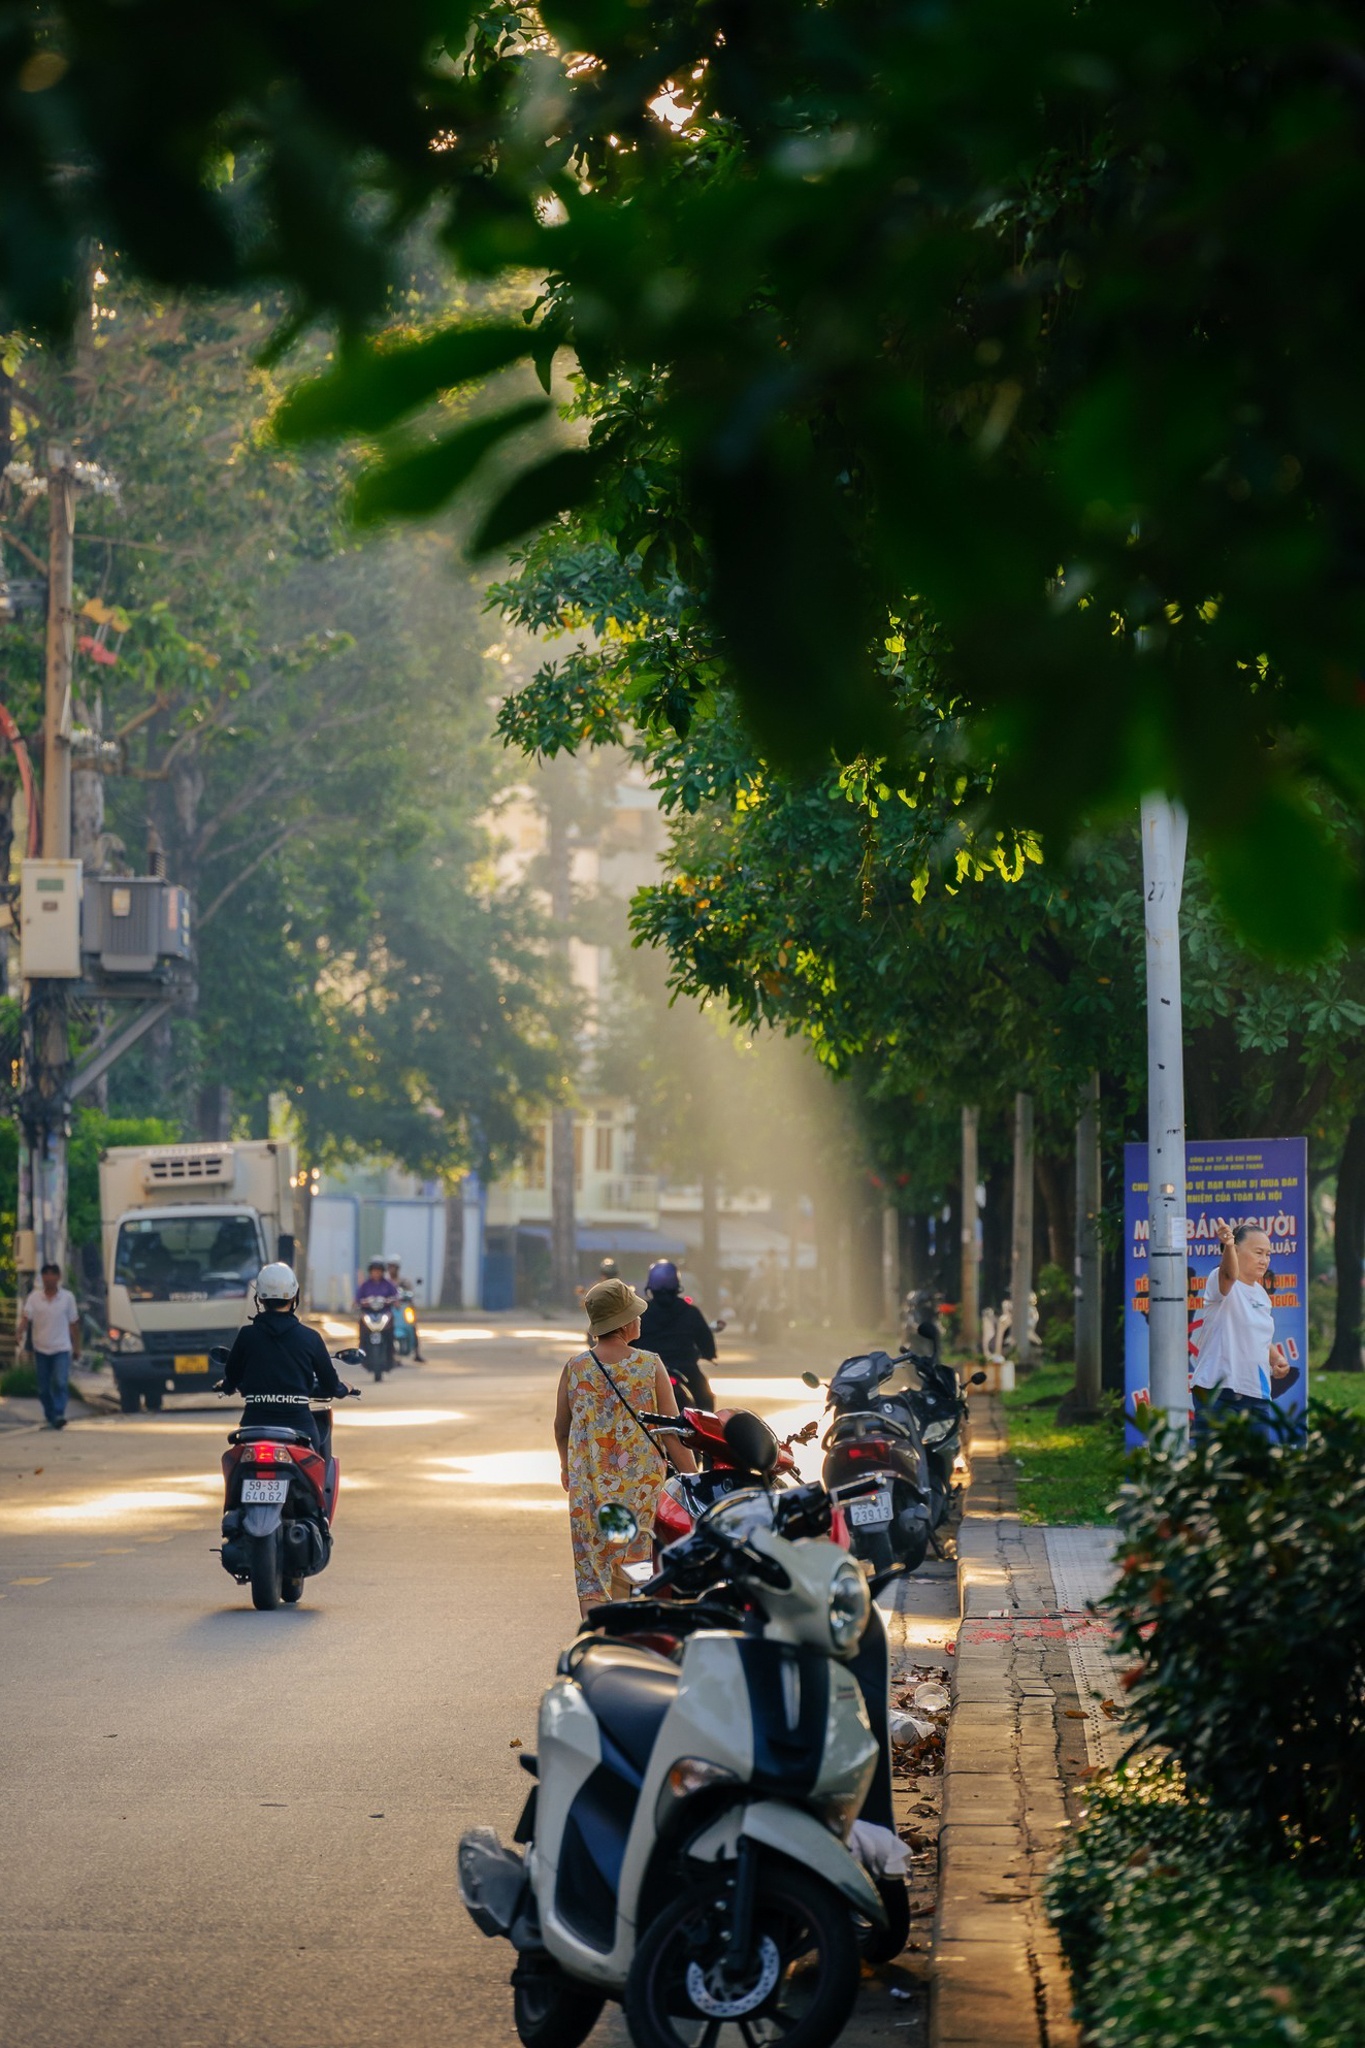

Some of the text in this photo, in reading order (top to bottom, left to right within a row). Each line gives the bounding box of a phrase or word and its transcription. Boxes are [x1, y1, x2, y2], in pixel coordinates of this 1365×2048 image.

[1133, 1243, 1147, 1258] LÀ
[1194, 1244, 1206, 1256] VI
[1271, 1239, 1298, 1255] LUẬT
[1134, 1273, 1150, 1292] NẾ
[249, 1481, 280, 1491] 59-S3
[245, 1491, 282, 1502] 640.62
[854, 1507, 890, 1524] 239.13
